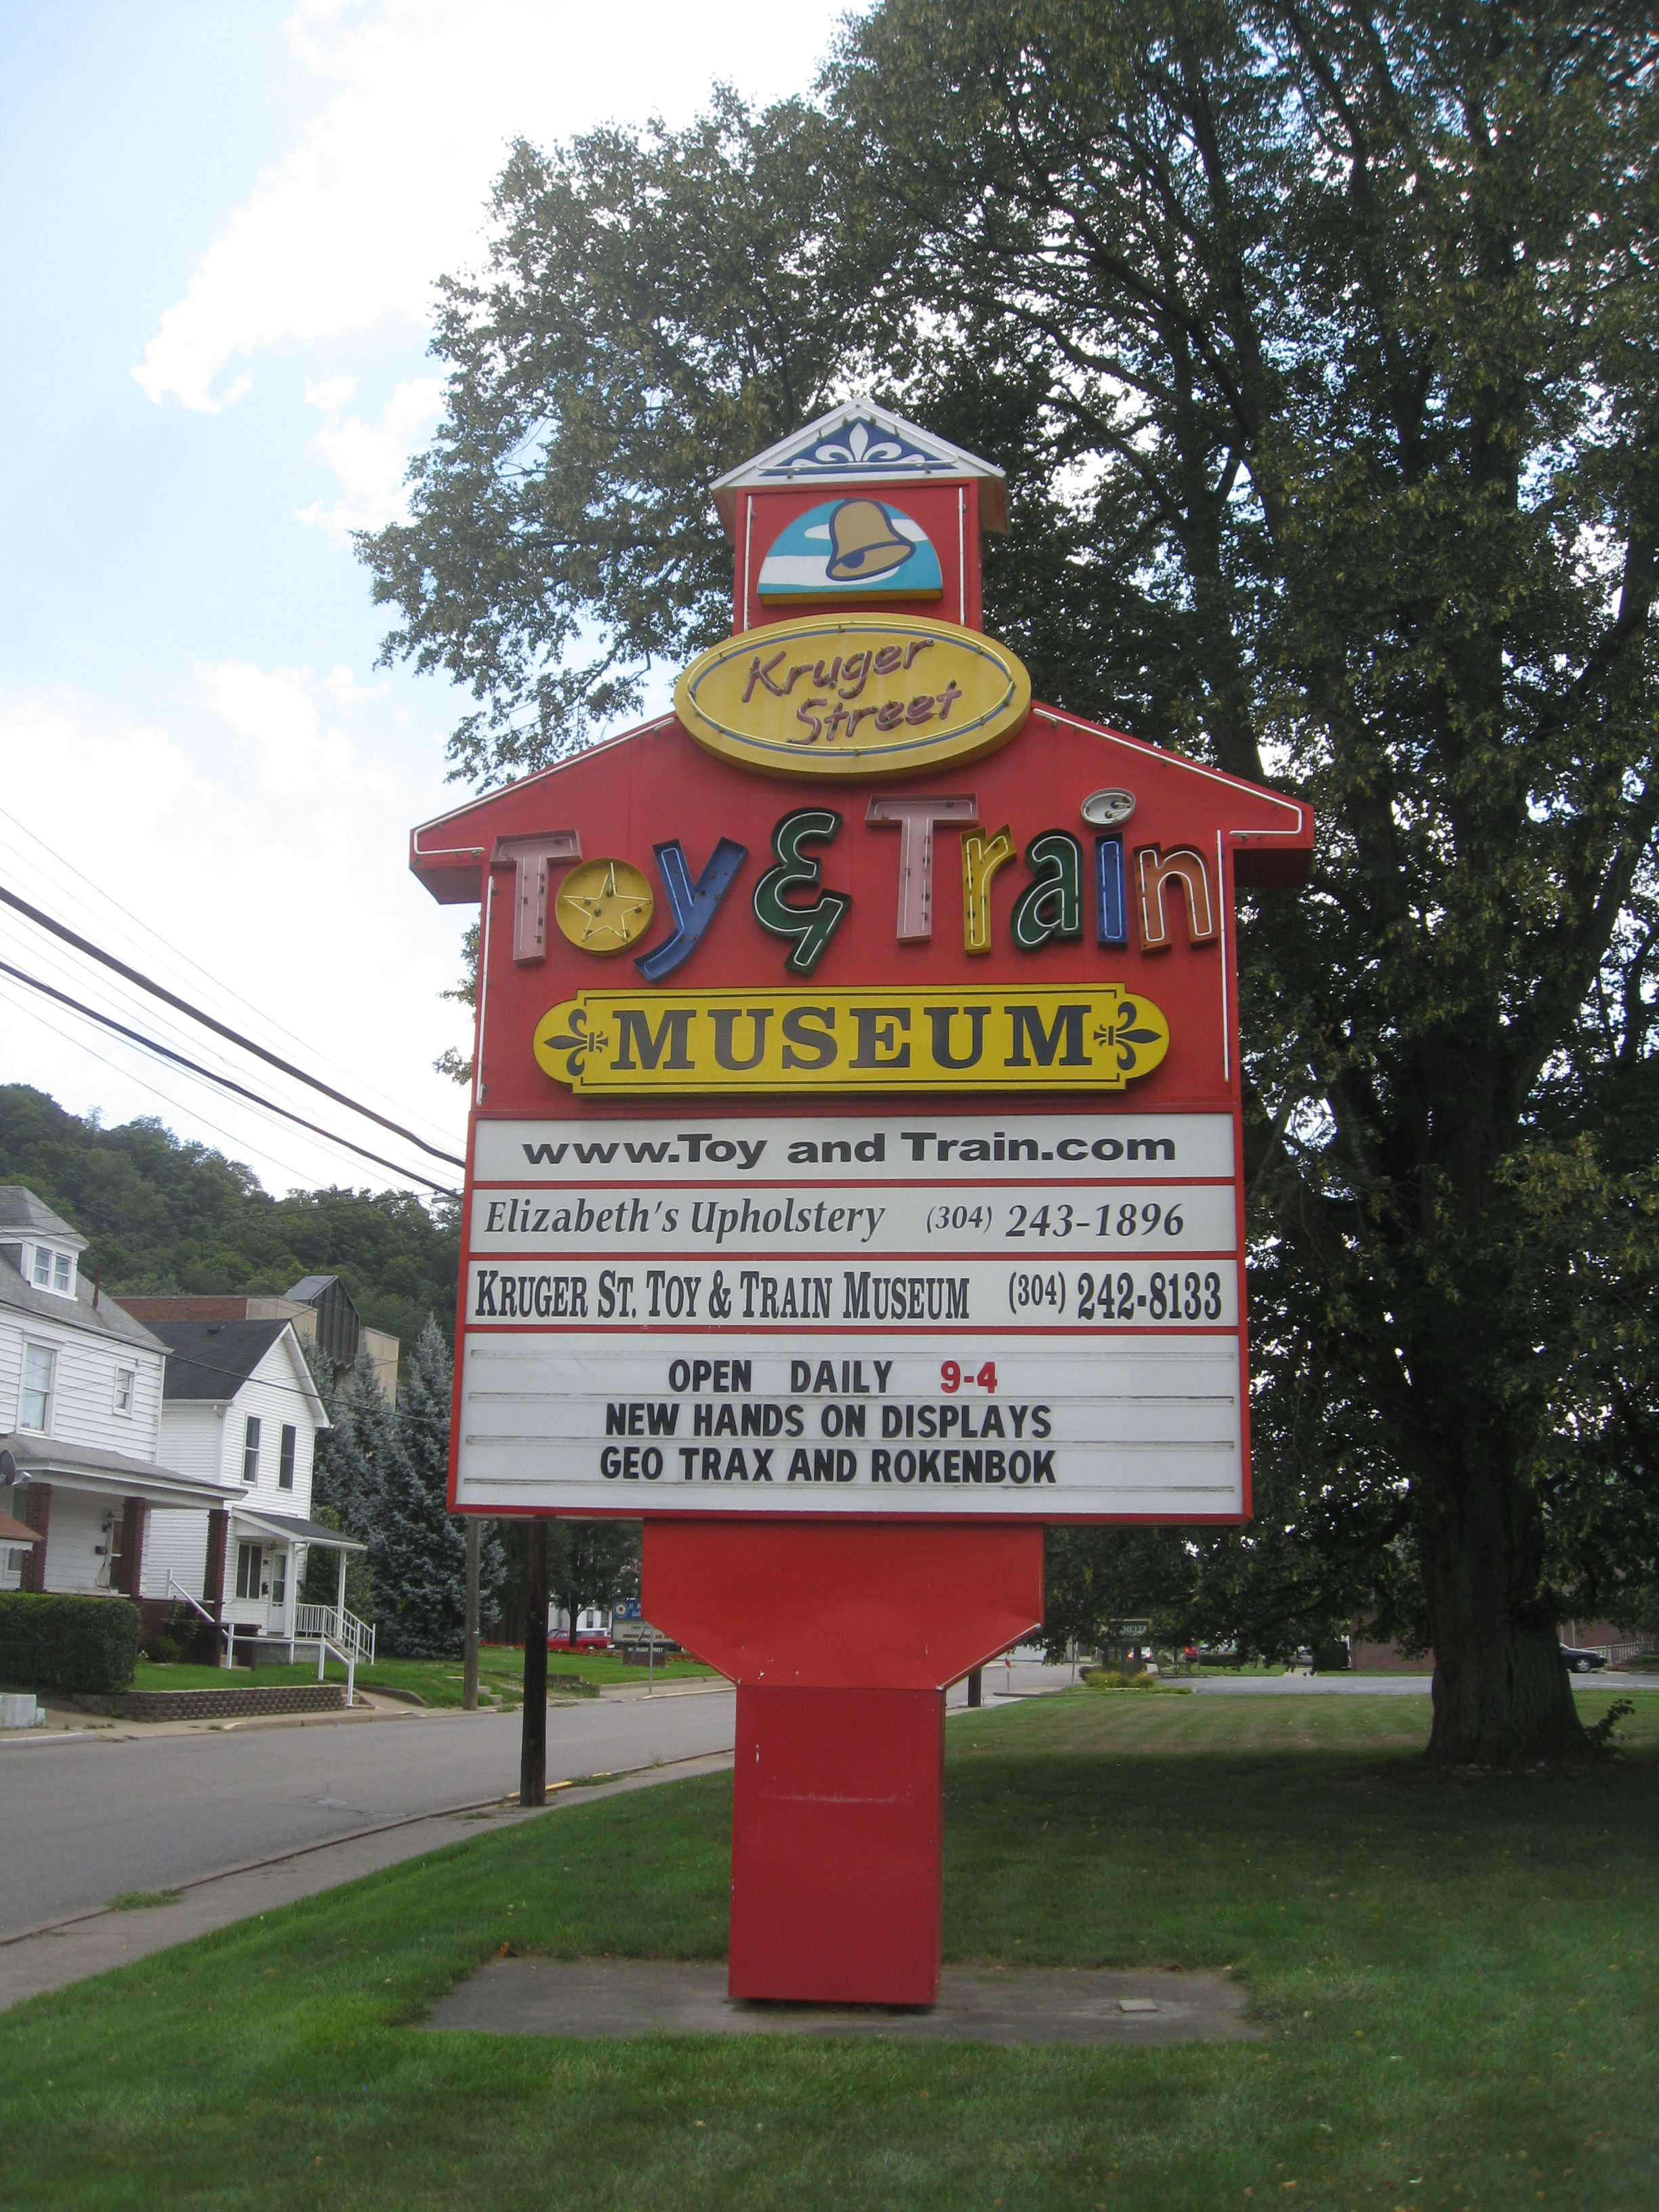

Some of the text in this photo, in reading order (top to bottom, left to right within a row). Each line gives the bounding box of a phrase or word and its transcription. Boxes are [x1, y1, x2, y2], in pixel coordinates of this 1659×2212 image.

[741, 638, 935, 703] Kruger
[786, 678, 962, 745] Street
[751, 806, 851, 977] &
[865, 787, 1218, 956] Train
[610, 1005, 1092, 1071] MUSEUM
[522, 1131, 1176, 1170] www.Toy and Train.com
[484, 1197, 1184, 1244] Elizabeth's Upholstery (304) 243-1896
[475, 1269, 1221, 1321] KRUGER ST. TOY & TRAIN MUSEUM (304) 242-8133
[668, 1359, 998, 1393] OPEN DAILY 9-4
[606, 1403, 1052, 1439] NEW HANDS ON DISPLAYS
[600, 1446, 1057, 1484] GEO TRAX AND ROKENBOK
